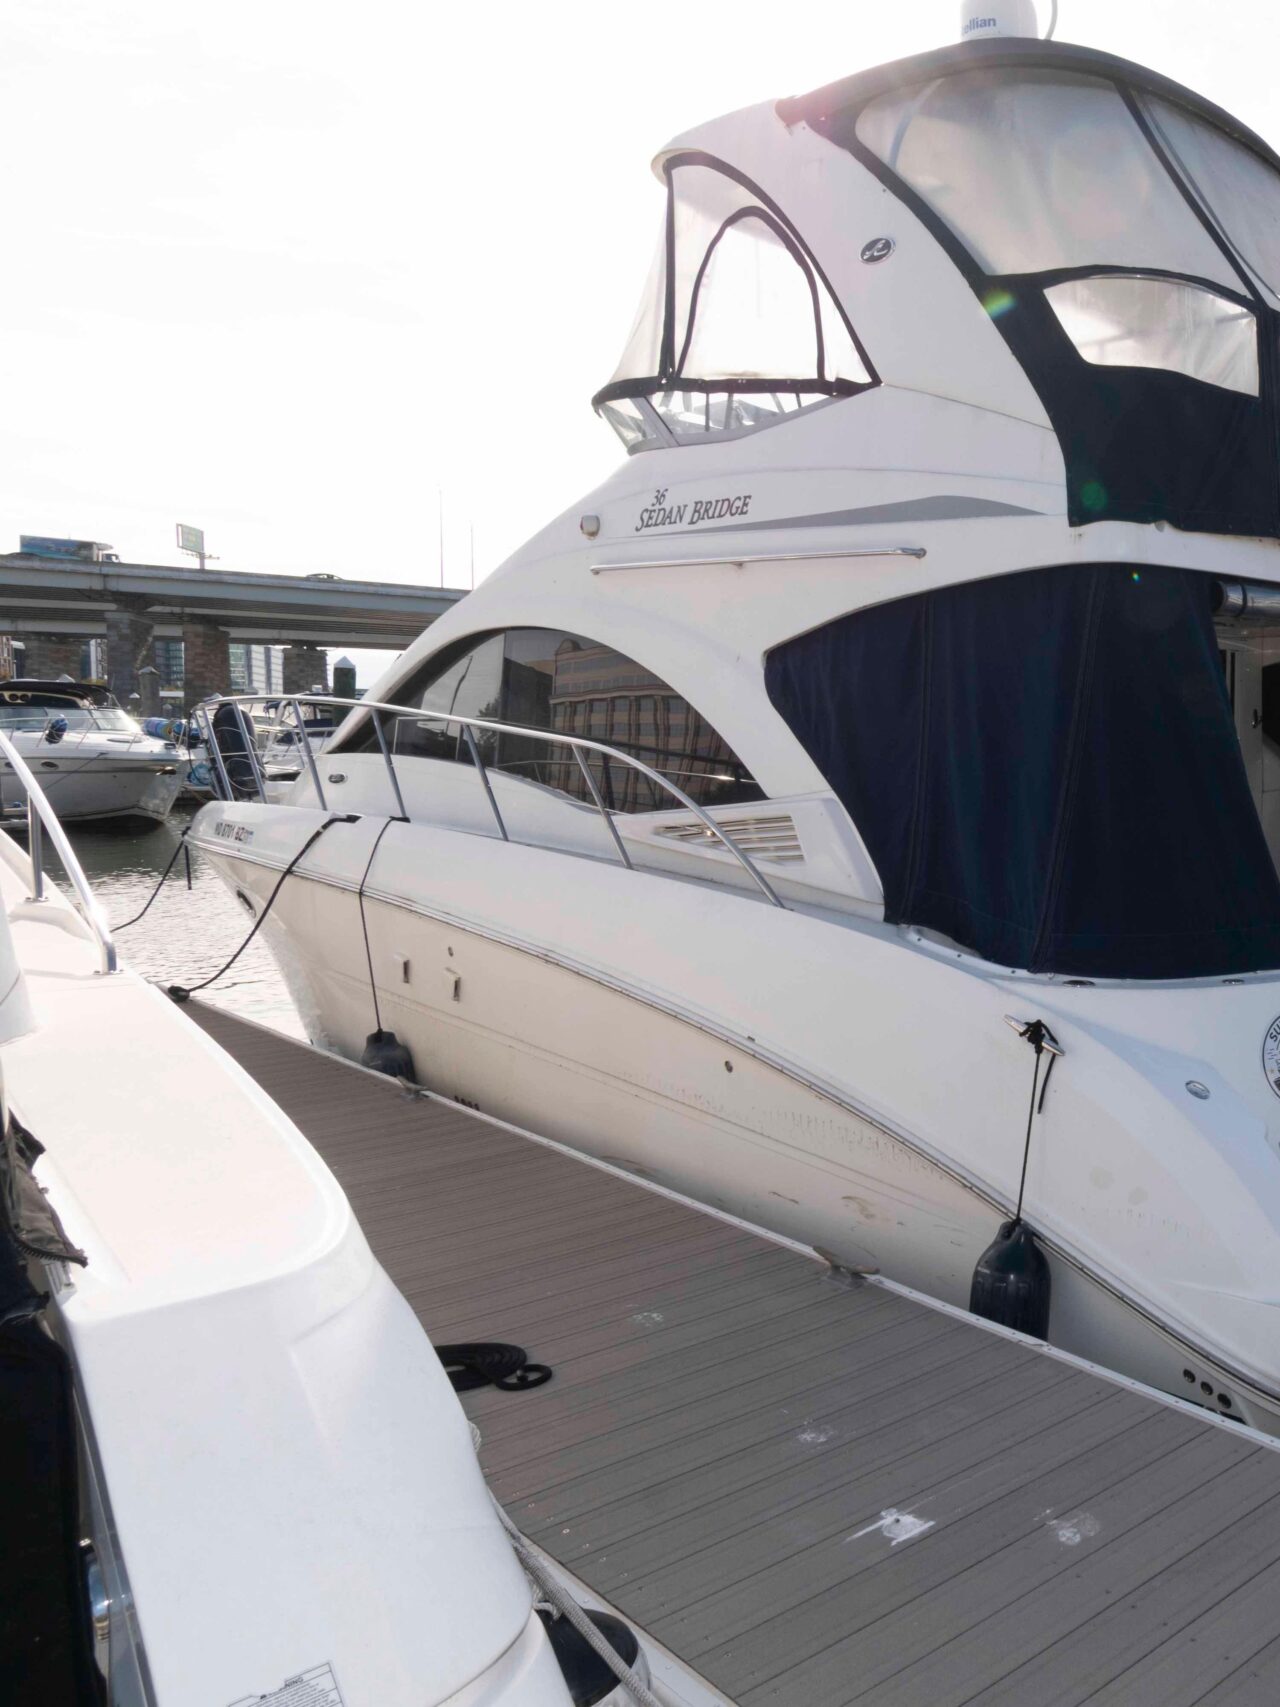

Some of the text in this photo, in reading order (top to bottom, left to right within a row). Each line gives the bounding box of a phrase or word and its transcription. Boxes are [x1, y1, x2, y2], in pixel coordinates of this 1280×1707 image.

[651, 488, 668, 507] 36
[635, 495, 752, 532] SEDAN BRIDGE
